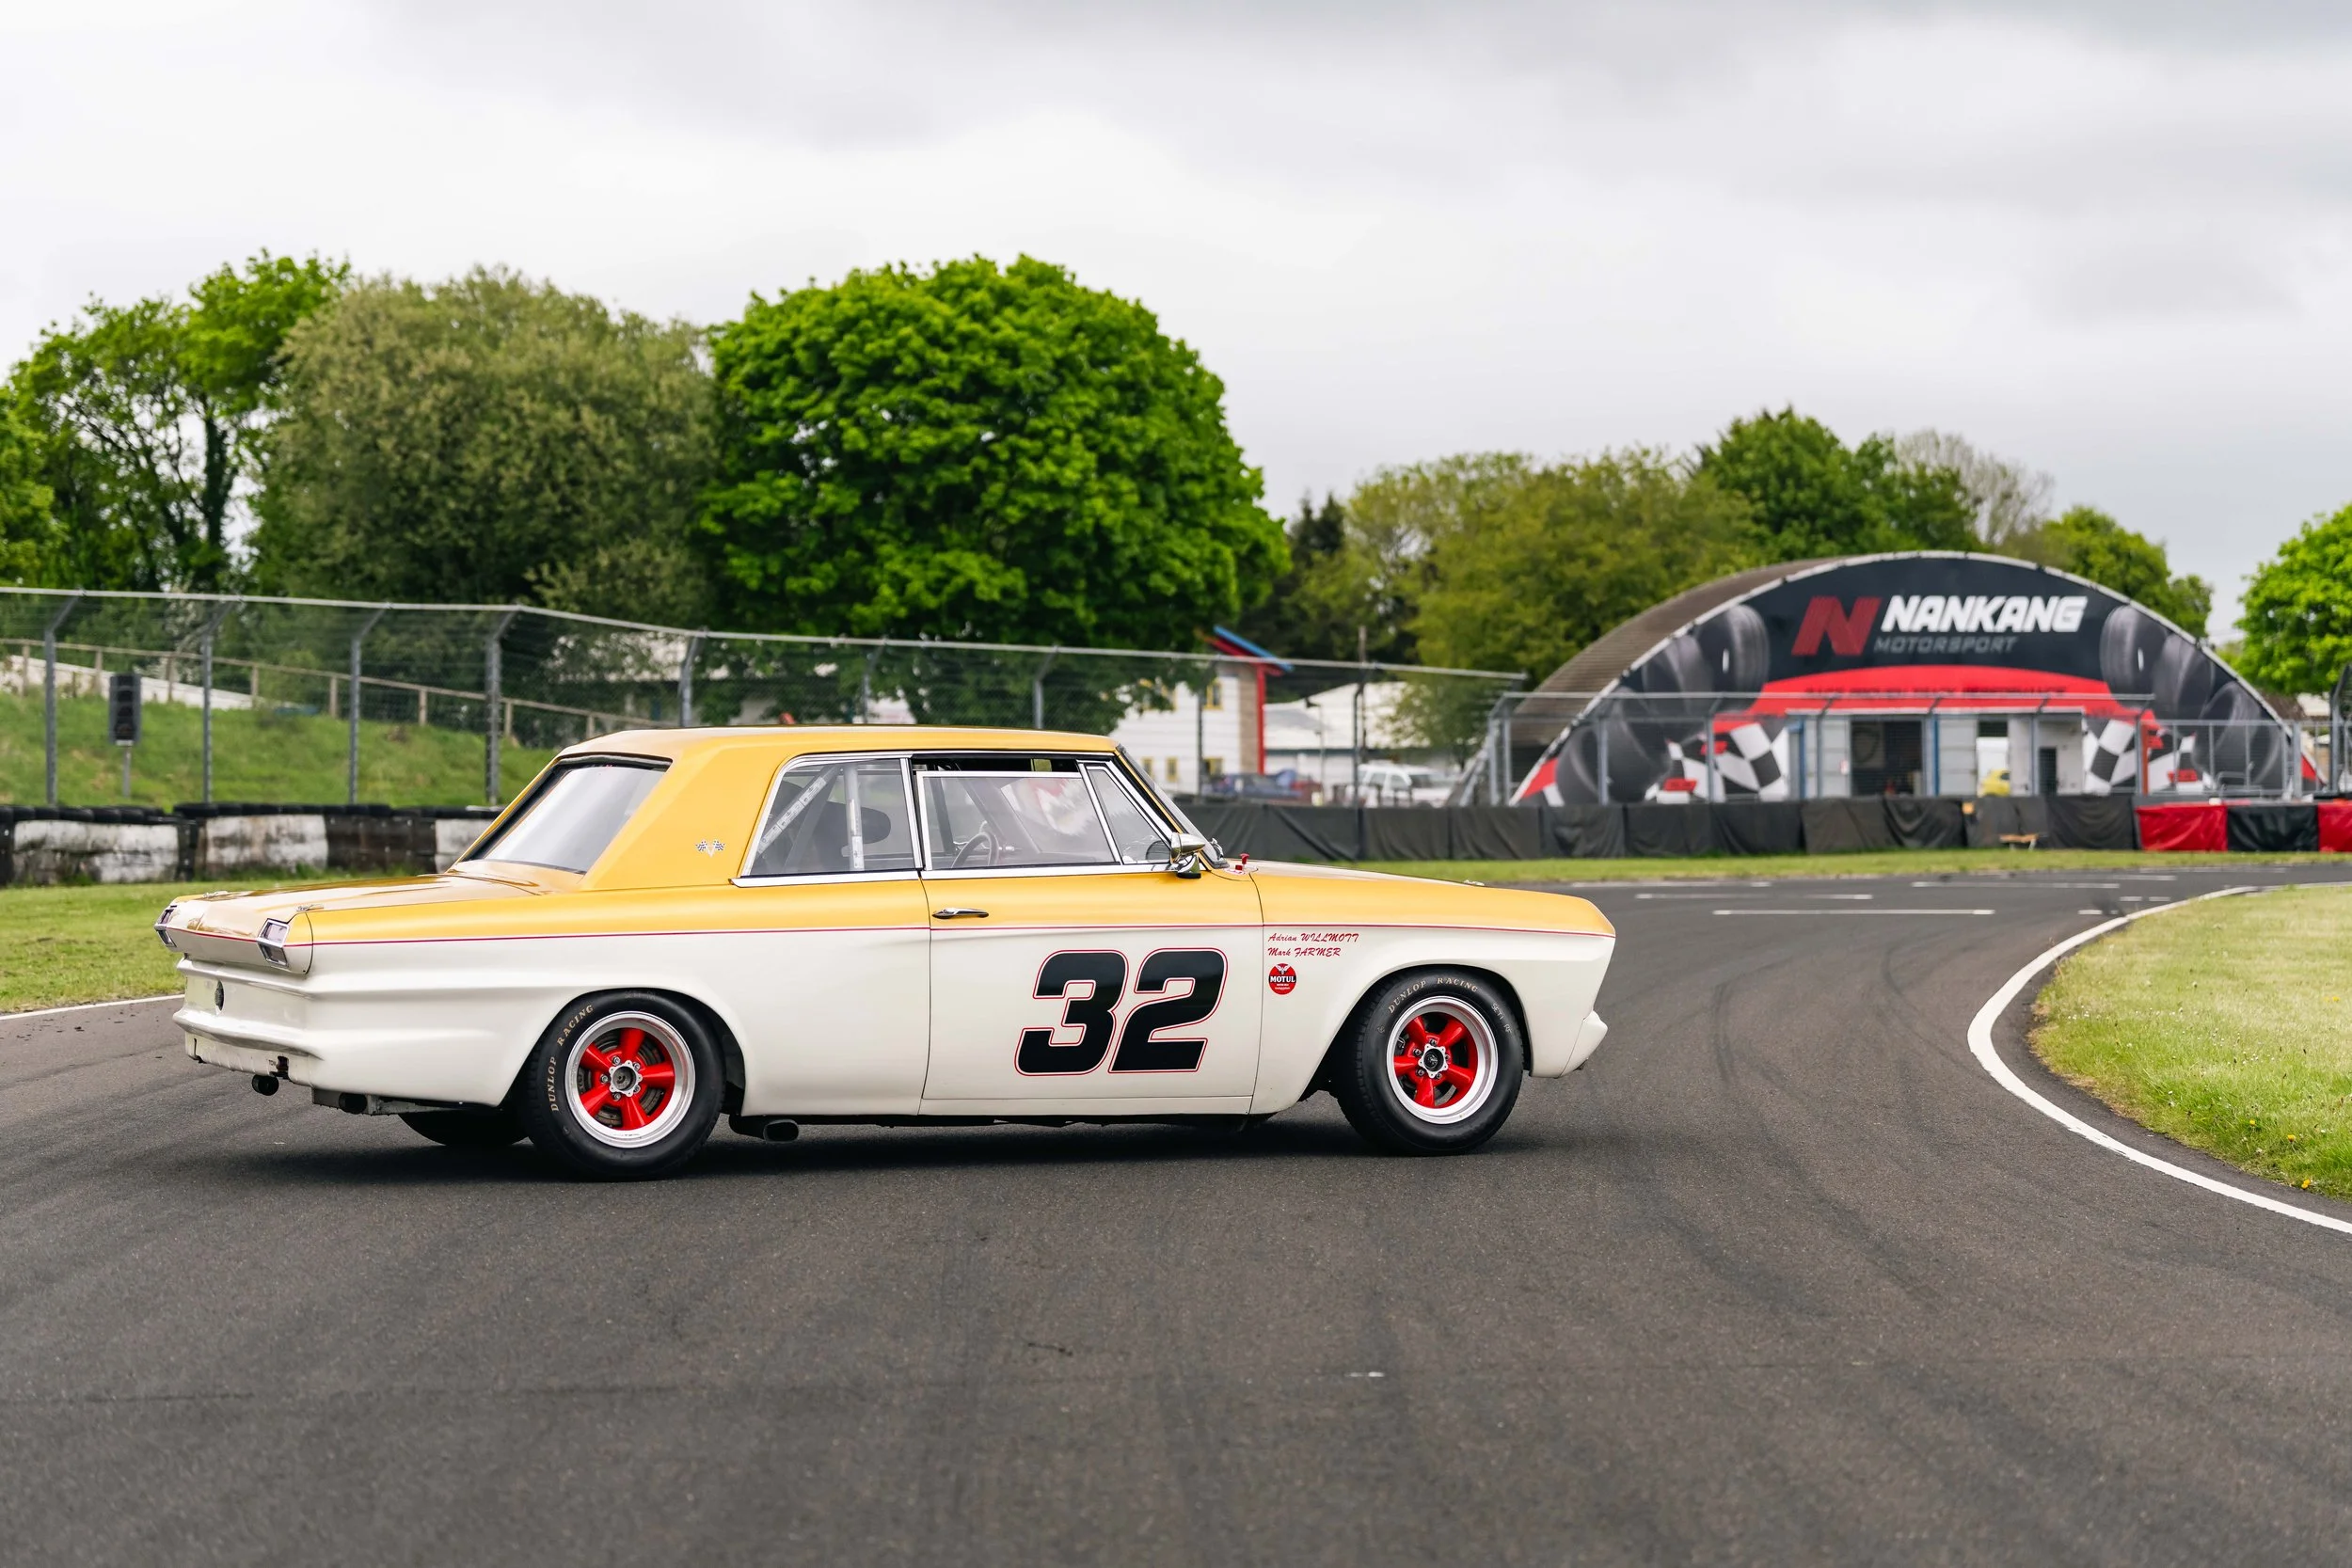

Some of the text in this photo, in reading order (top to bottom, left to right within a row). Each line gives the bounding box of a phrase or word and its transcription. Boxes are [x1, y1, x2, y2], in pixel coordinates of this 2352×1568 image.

[1882, 595, 2088, 632] NANKANG
[1873, 635, 2018, 655] MOTORSPORT
[1267, 947, 1341, 958] Mark FARMER
[1268, 932, 1359, 942] Adrian WILLMOTT
[1014, 947, 1229, 1076] 32
[1388, 977, 1478, 1014] DUNLOP RACING
[547, 1004, 595, 1112] DUNLOP RACING
